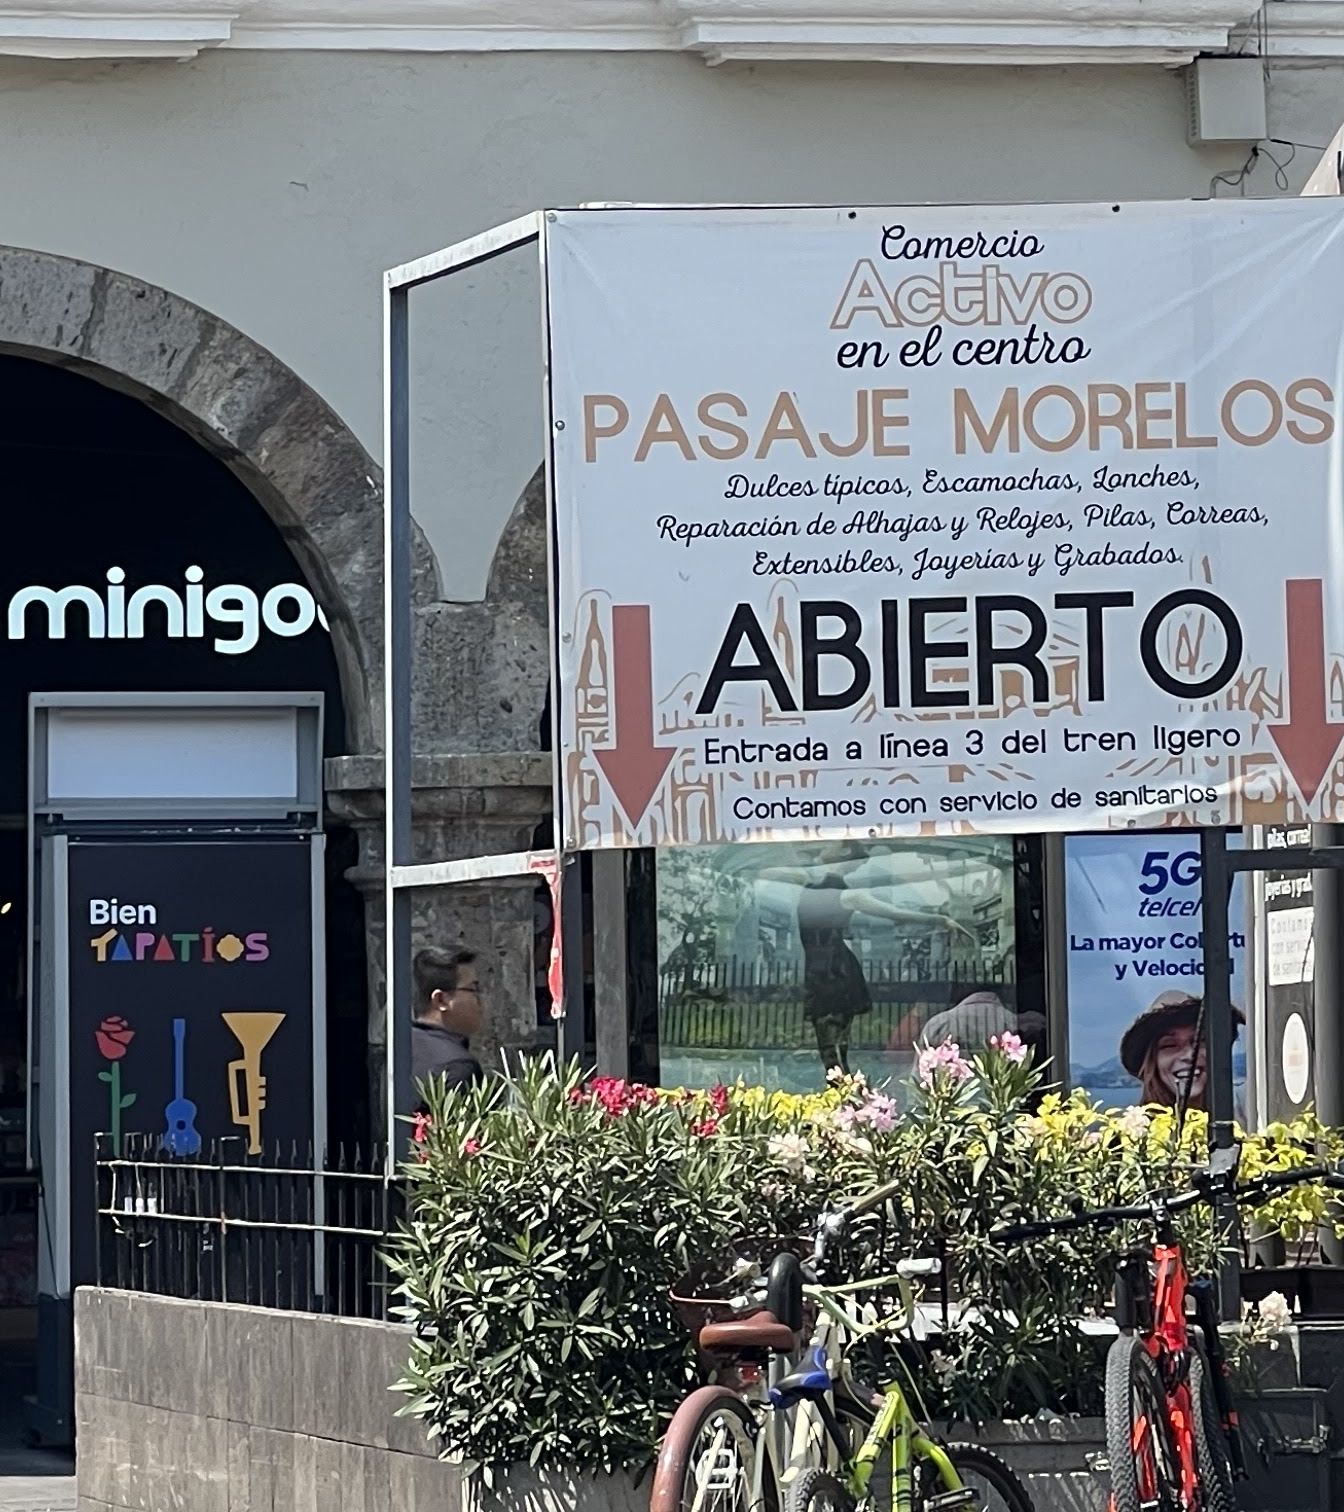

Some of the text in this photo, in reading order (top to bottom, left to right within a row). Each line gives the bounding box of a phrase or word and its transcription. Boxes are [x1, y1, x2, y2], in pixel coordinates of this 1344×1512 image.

[881, 225, 1044, 261] Comercio
[829, 259, 1093, 330] Activo
[836, 326, 1092, 369] en el centro
[583, 378, 1337, 463] PASAJE MORELOS
[724, 474, 820, 499] Dulces
[823, 473, 913, 505] típicos,
[922, 467, 1083, 494] Escamochas,
[656, 501, 1270, 548] Reparación de Alhajas y Relojes, Pilas, Correas,
[752, 550, 905, 577] Extensibles,
[1027, 552, 1047, 577] y
[1055, 541, 1184, 577] Grabados.
[8, 565, 330, 654] minigo
[696, 588, 1244, 714] ABIERTO
[705, 737, 828, 764] Entrada
[846, 741, 862, 760] a
[965, 729, 984, 756] 3
[1001, 728, 1047, 754] del
[1064, 727, 1137, 752] tren
[734, 785, 1218, 820] Contamos con servicio de sanitarios
[1138, 851, 1203, 895] 5G
[90, 898, 157, 926] Bien
[1070, 935, 1166, 954] La mayor
[1115, 963, 1128, 981] y
